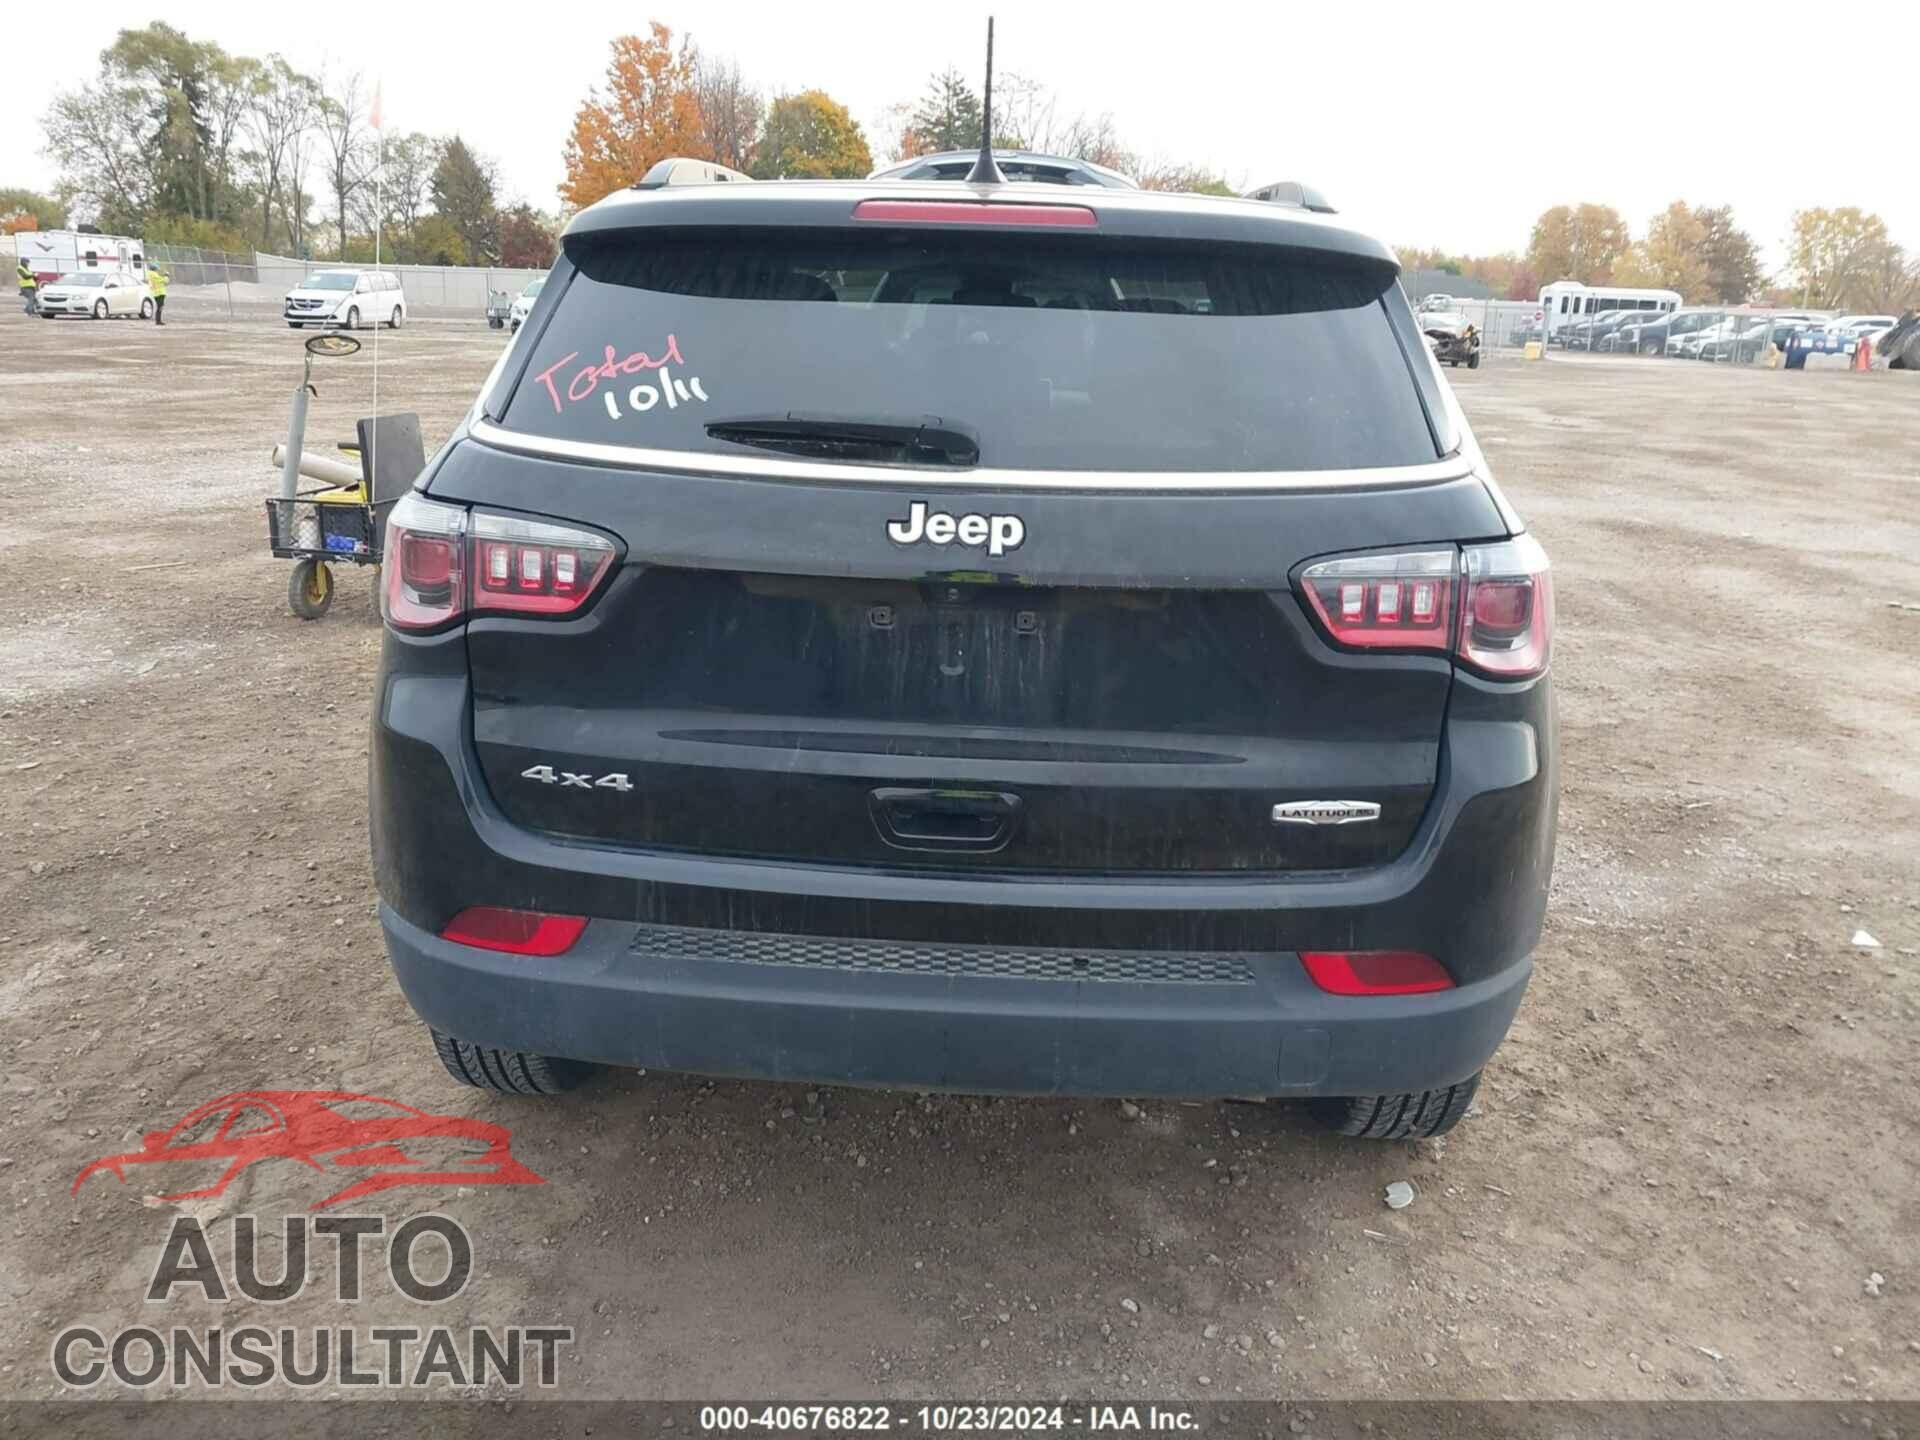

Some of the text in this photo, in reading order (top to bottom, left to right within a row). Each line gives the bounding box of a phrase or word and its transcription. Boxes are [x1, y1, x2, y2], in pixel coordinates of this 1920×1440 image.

[886, 501, 1026, 557] Jeep
[520, 765, 634, 791] 4x4
[1281, 809, 1355, 817] LATITUDE
